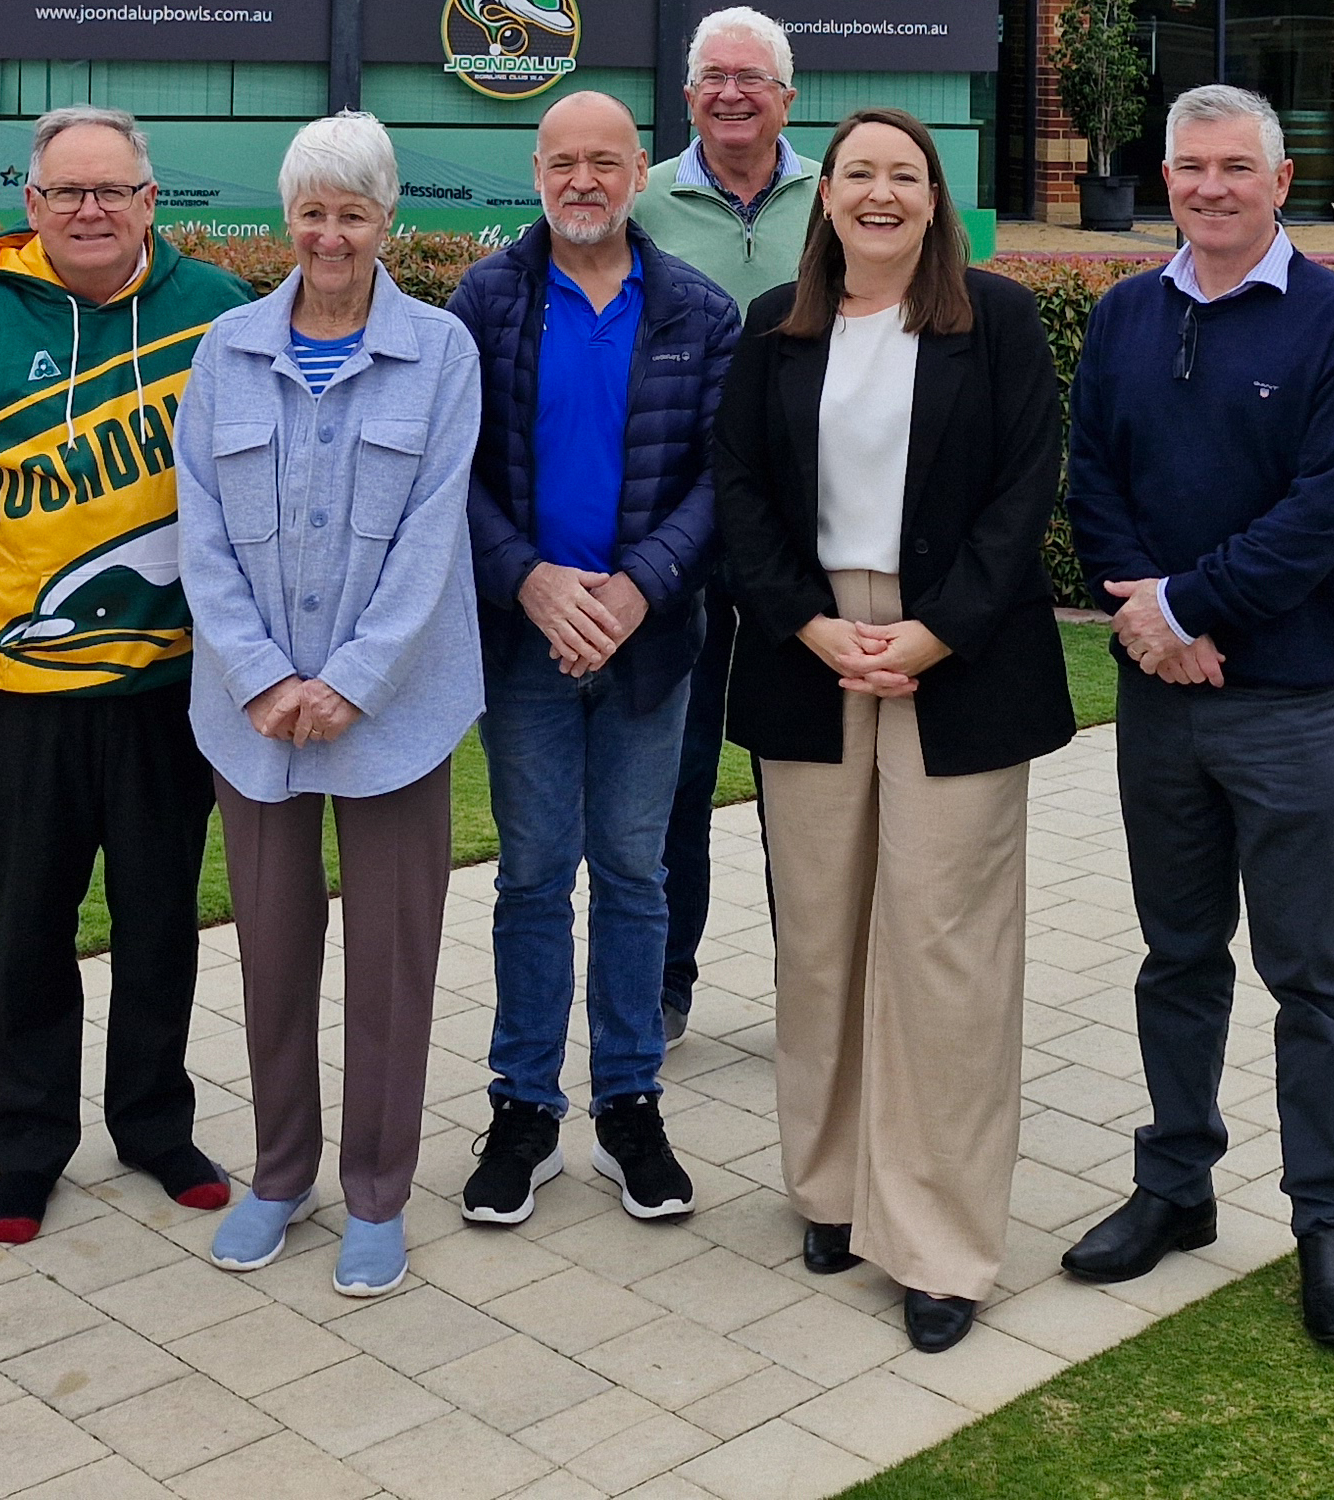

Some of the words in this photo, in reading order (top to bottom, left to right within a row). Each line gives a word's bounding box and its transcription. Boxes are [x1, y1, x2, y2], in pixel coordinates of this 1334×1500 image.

[35, 4, 273, 24] www.joondalupbowls.com.au
[444, 55, 576, 74] JOONDALUP
[173, 189, 220, 197] SATURDAY
[486, 198, 513, 206] MEN'S
